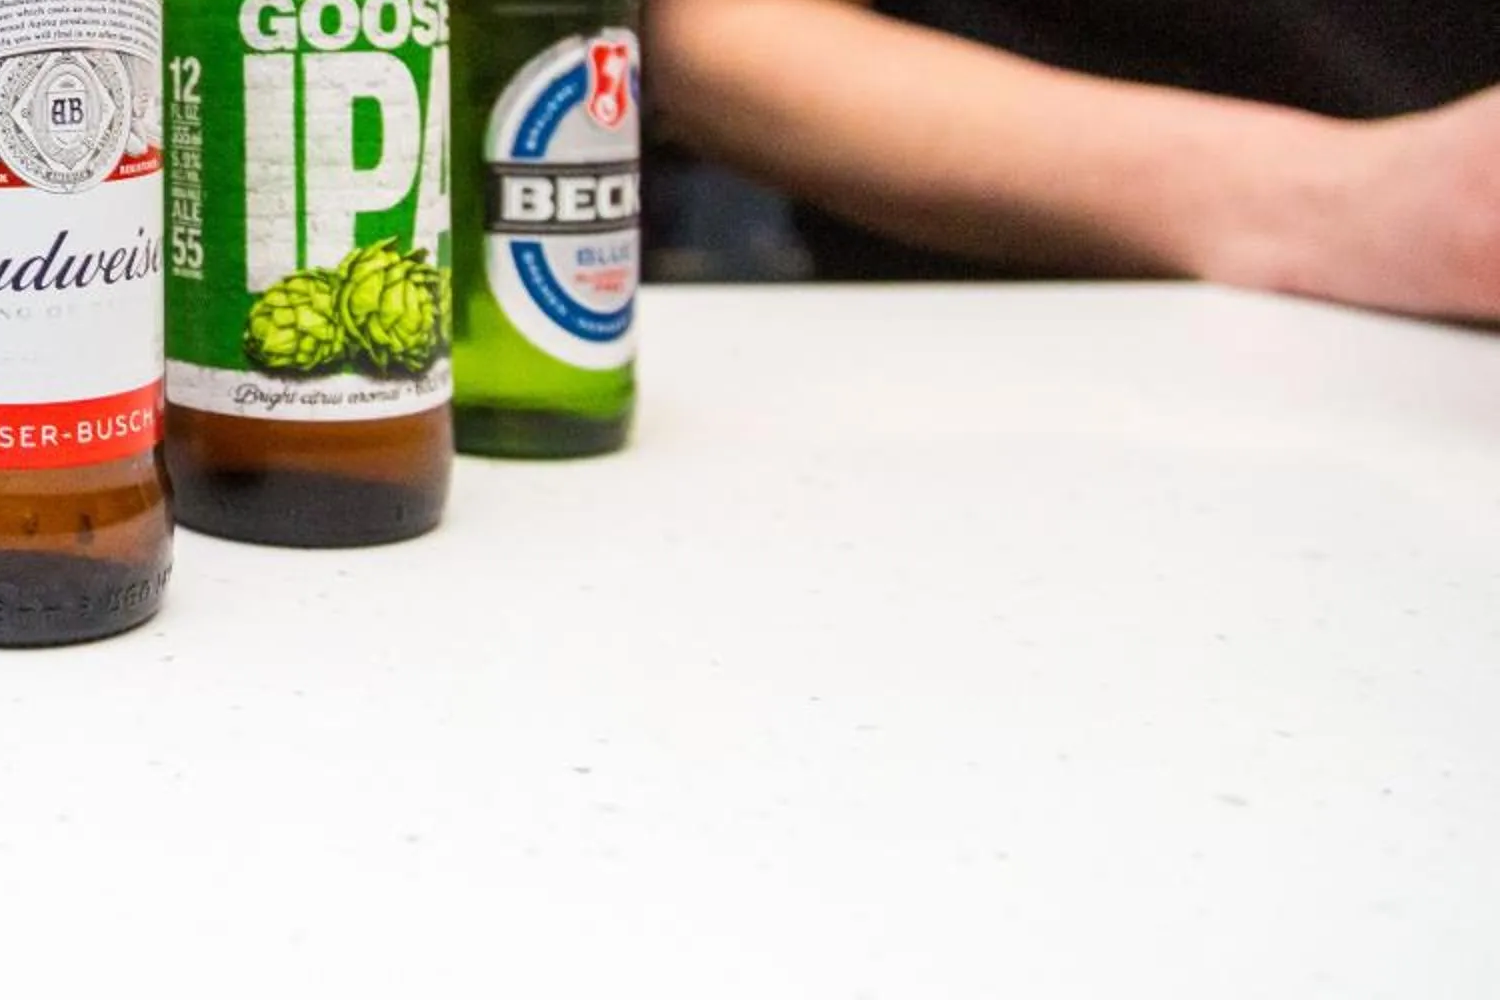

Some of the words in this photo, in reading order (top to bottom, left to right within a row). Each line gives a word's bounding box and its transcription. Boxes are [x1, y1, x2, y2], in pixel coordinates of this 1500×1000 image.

[169, 55, 202, 103] 12
[171, 225, 205, 270] 55
[233, 382, 297, 411] Bright
